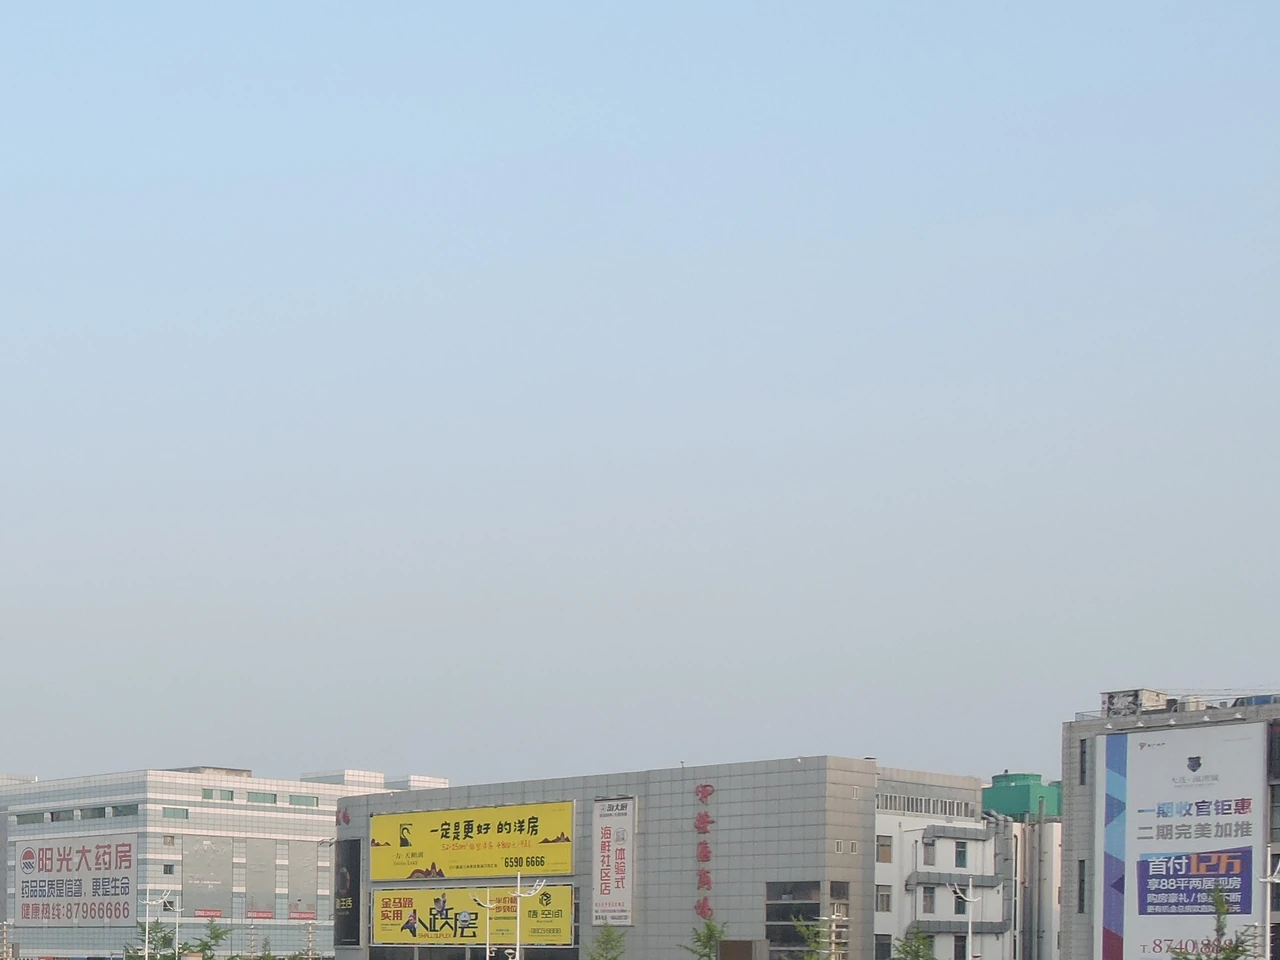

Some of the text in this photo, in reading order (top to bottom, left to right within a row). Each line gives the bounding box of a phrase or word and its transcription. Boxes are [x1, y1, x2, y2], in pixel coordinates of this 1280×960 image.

[1138, 798, 1252, 818] 一期收官钜惠
[1137, 821, 1252, 840] 二期完美加推
[38, 843, 132, 873] 阳光大药房
[504, 857, 523, 868] 6590
[525, 856, 545, 867] 6666
[600, 826, 612, 895] 海鲜社区店
[614, 847, 626, 889] 体验式
[381, 897, 414, 909] 金马路
[380, 910, 403, 921] 实用
